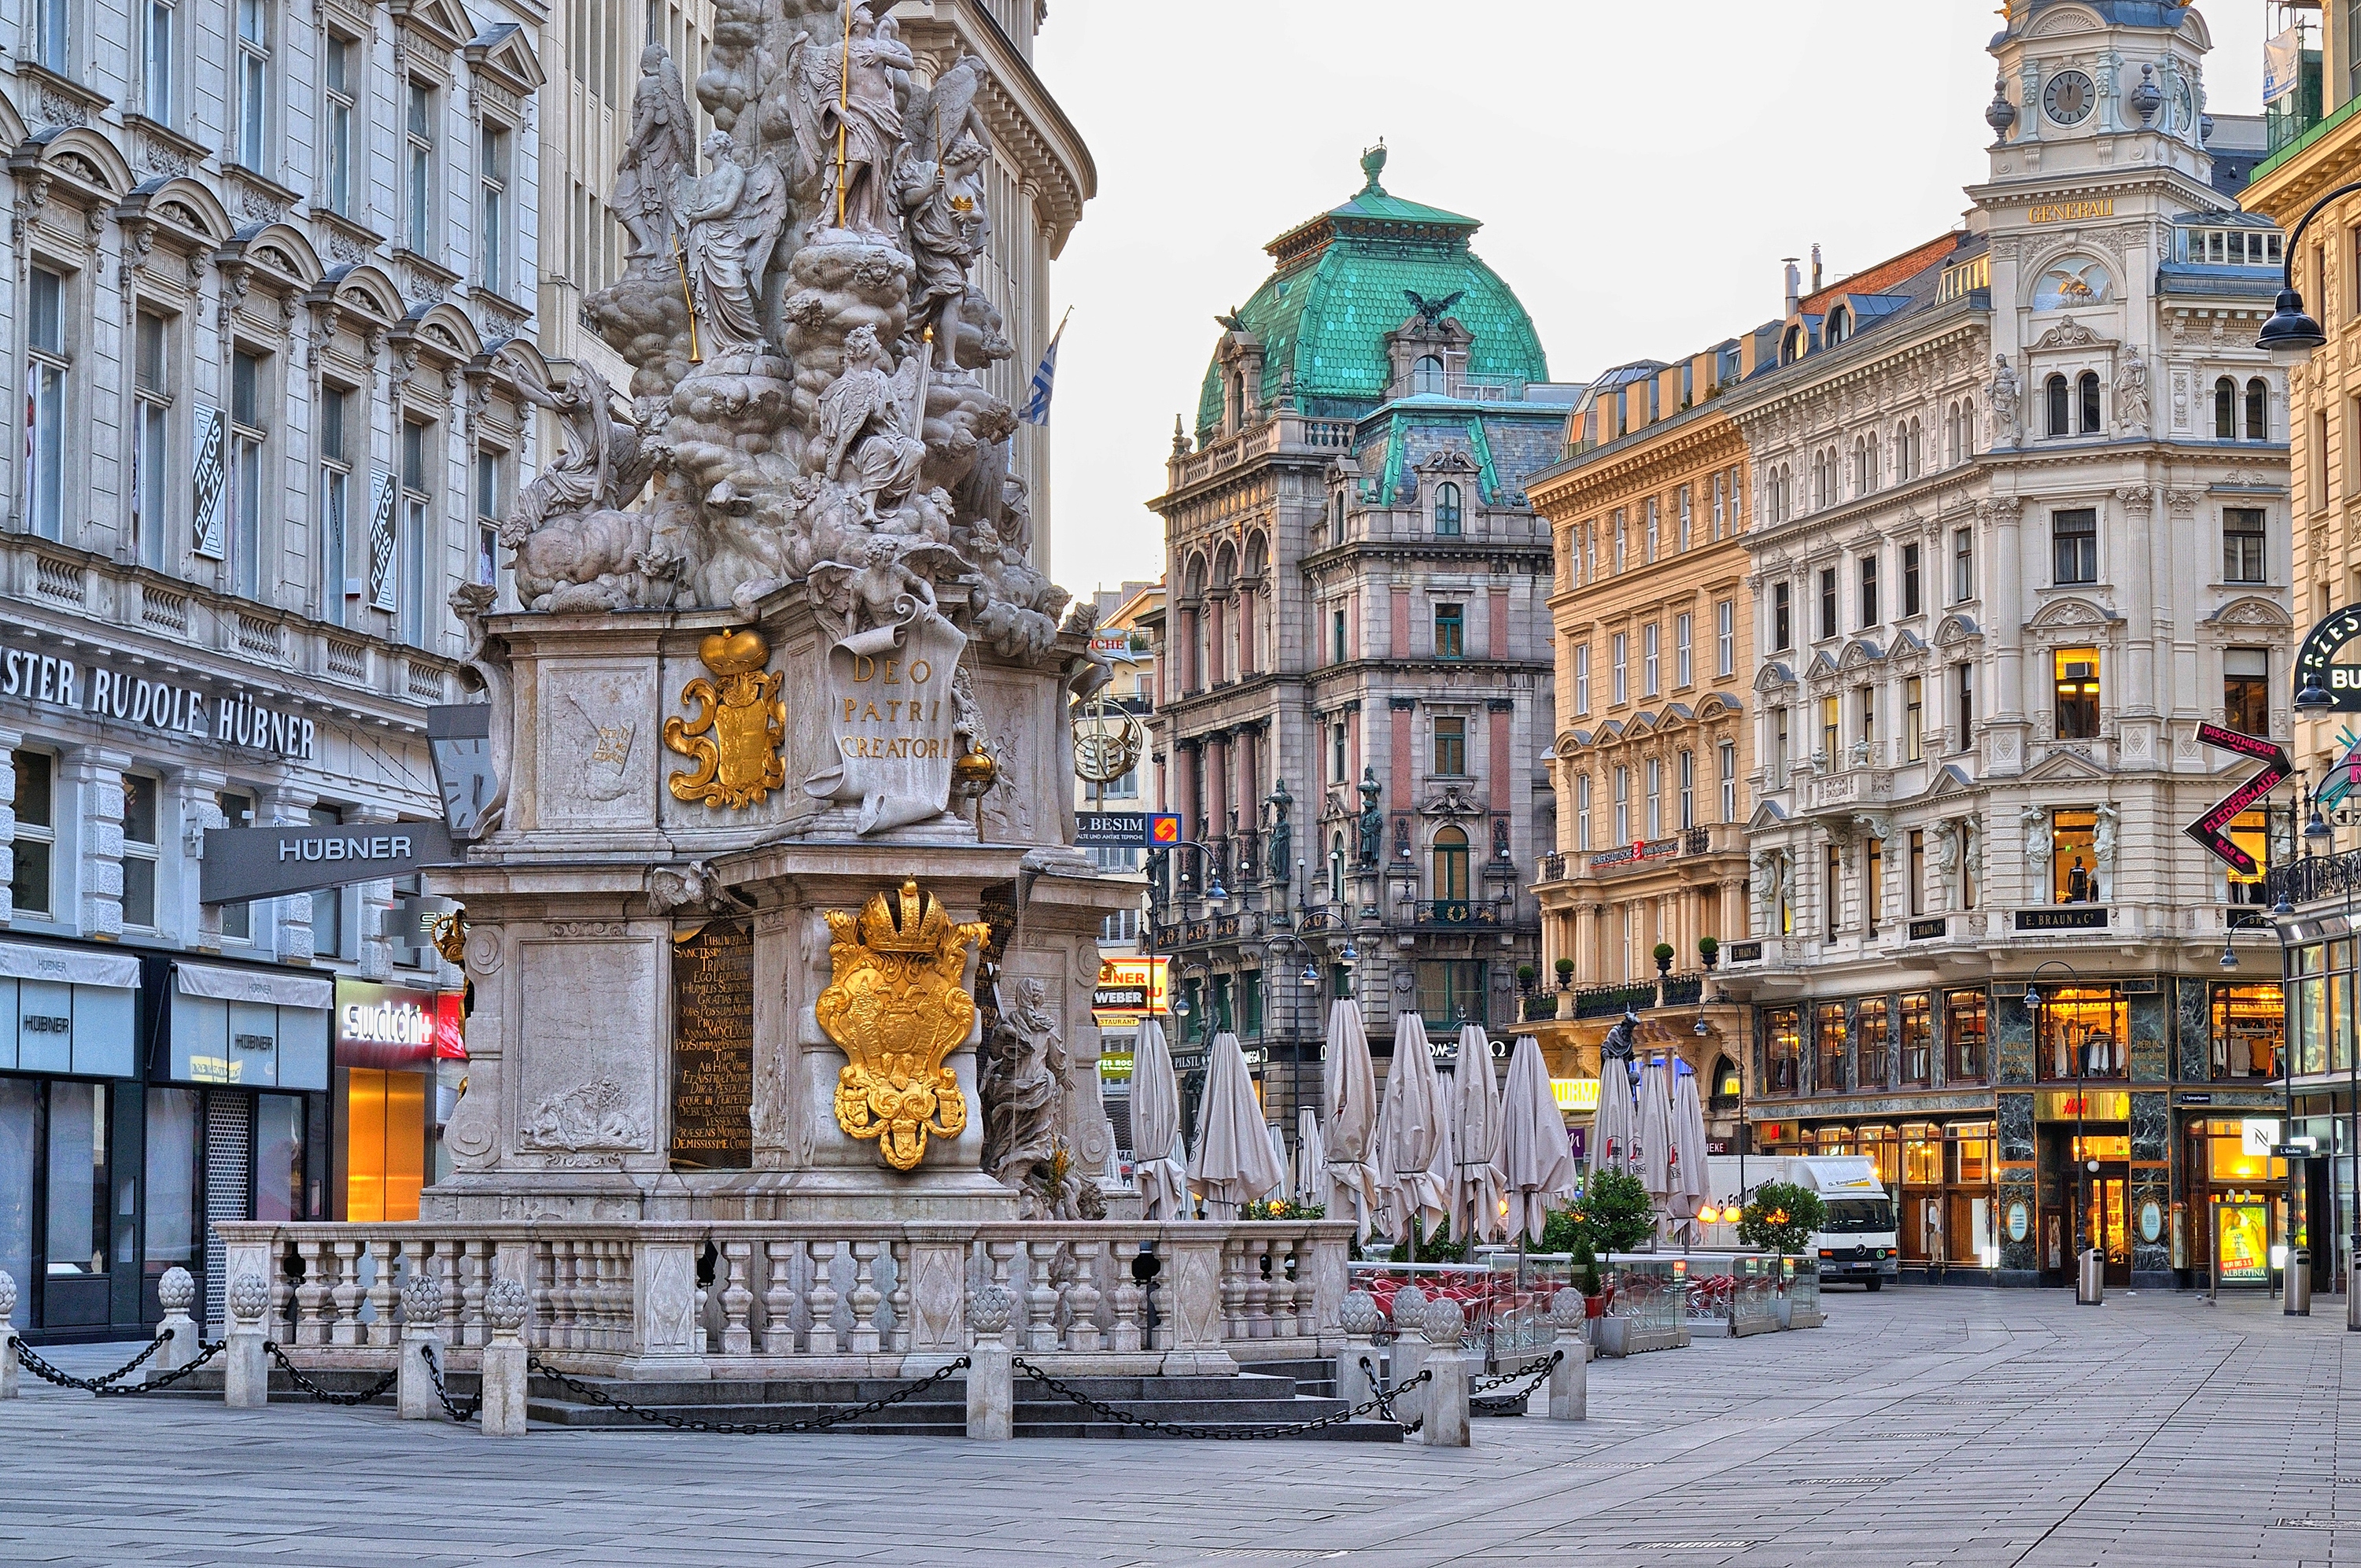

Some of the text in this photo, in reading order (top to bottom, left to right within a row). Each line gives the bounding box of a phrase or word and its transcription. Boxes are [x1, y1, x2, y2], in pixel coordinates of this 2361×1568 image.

[2028, 198, 2114, 223] GENERALI
[194, 419, 222, 496] ZIKOS
[194, 459, 223, 540] PELZE
[371, 483, 394, 554] ZIKOS
[371, 535, 392, 594] FURS
[854, 655, 931, 684] DEO
[94, 666, 203, 733] RUDOLF
[218, 691, 315, 760] HÜBNER
[843, 697, 941, 722] PATRI
[841, 736, 950, 759] CREATORI
[2203, 725, 2277, 756] DISCOTHEQUE
[2203, 771, 2281, 834] FLEDERMAUS
[2223, 784, 2250, 806] CABARET
[1090, 817, 1144, 831] BESIM
[279, 836, 412, 861] HÜBNER
[2216, 839, 2237, 857] BAR
[1917, 922, 1934, 935] BRAUN
[2025, 915, 2035, 926] E.
[2038, 913, 2073, 925] BRAUN
[38, 959, 67, 973] HÜBNER
[248, 981, 272, 995] HÜBNER
[697, 992, 732, 1005] GRATIAS
[1094, 991, 1143, 1004] WEBER
[23, 1013, 69, 1035] HÜBNER
[697, 1016, 714, 1028] PRO
[235, 1033, 274, 1051] HÜBNER
[2005, 1042, 2028, 1050] BERLIN
[2137, 1040, 2160, 1049] BERLIN
[698, 1061, 712, 1073] AB
[712, 1060, 731, 1072] HAC
[2006, 1064, 2027, 1075] PRAG
[705, 1095, 713, 1105] IN
[2223, 1268, 2266, 1277] ALBERTINA
